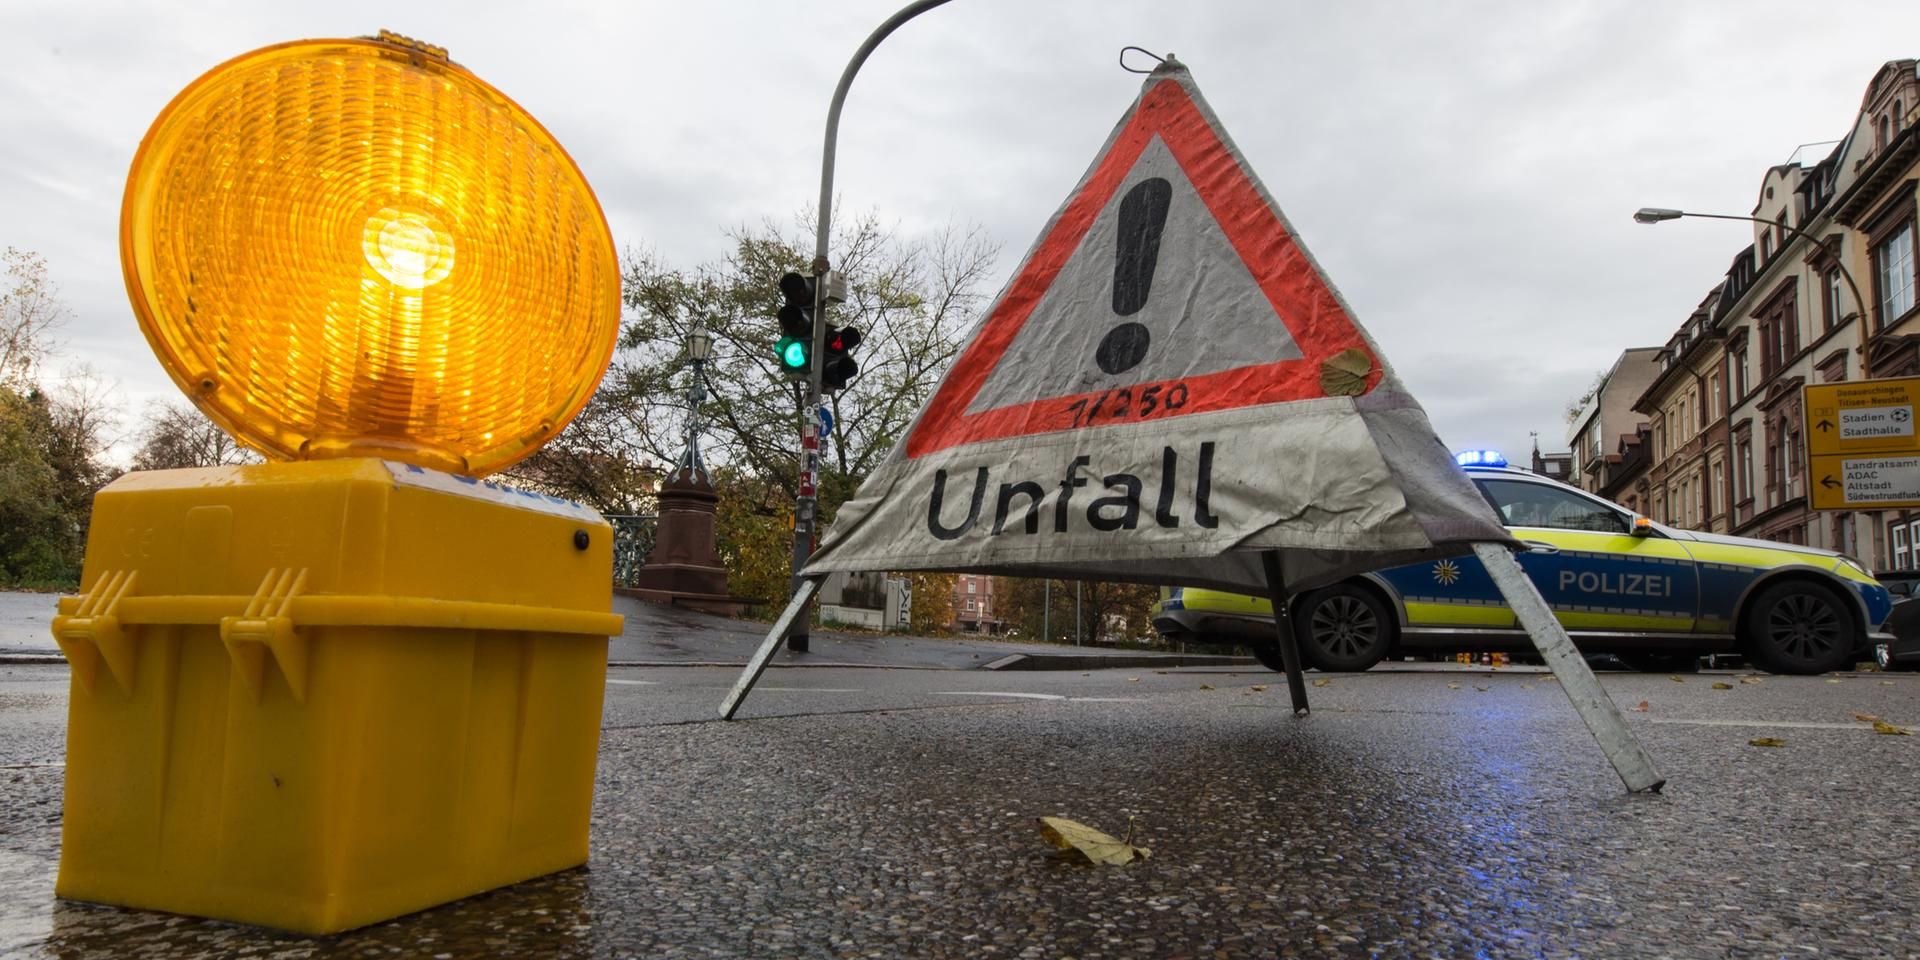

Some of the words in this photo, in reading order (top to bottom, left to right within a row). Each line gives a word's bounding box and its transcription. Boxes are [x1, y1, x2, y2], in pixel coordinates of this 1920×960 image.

[1843, 414, 1885, 423] Stadien
[1844, 426, 1901, 436] Stadthalle
[1845, 459, 1918, 470] Landratsamt
[1847, 471, 1879, 480] ADAC
[927, 441, 1219, 540] Unfall
[1847, 481, 1892, 490] Altstadt
[1559, 570, 1671, 597] POLIZEI
